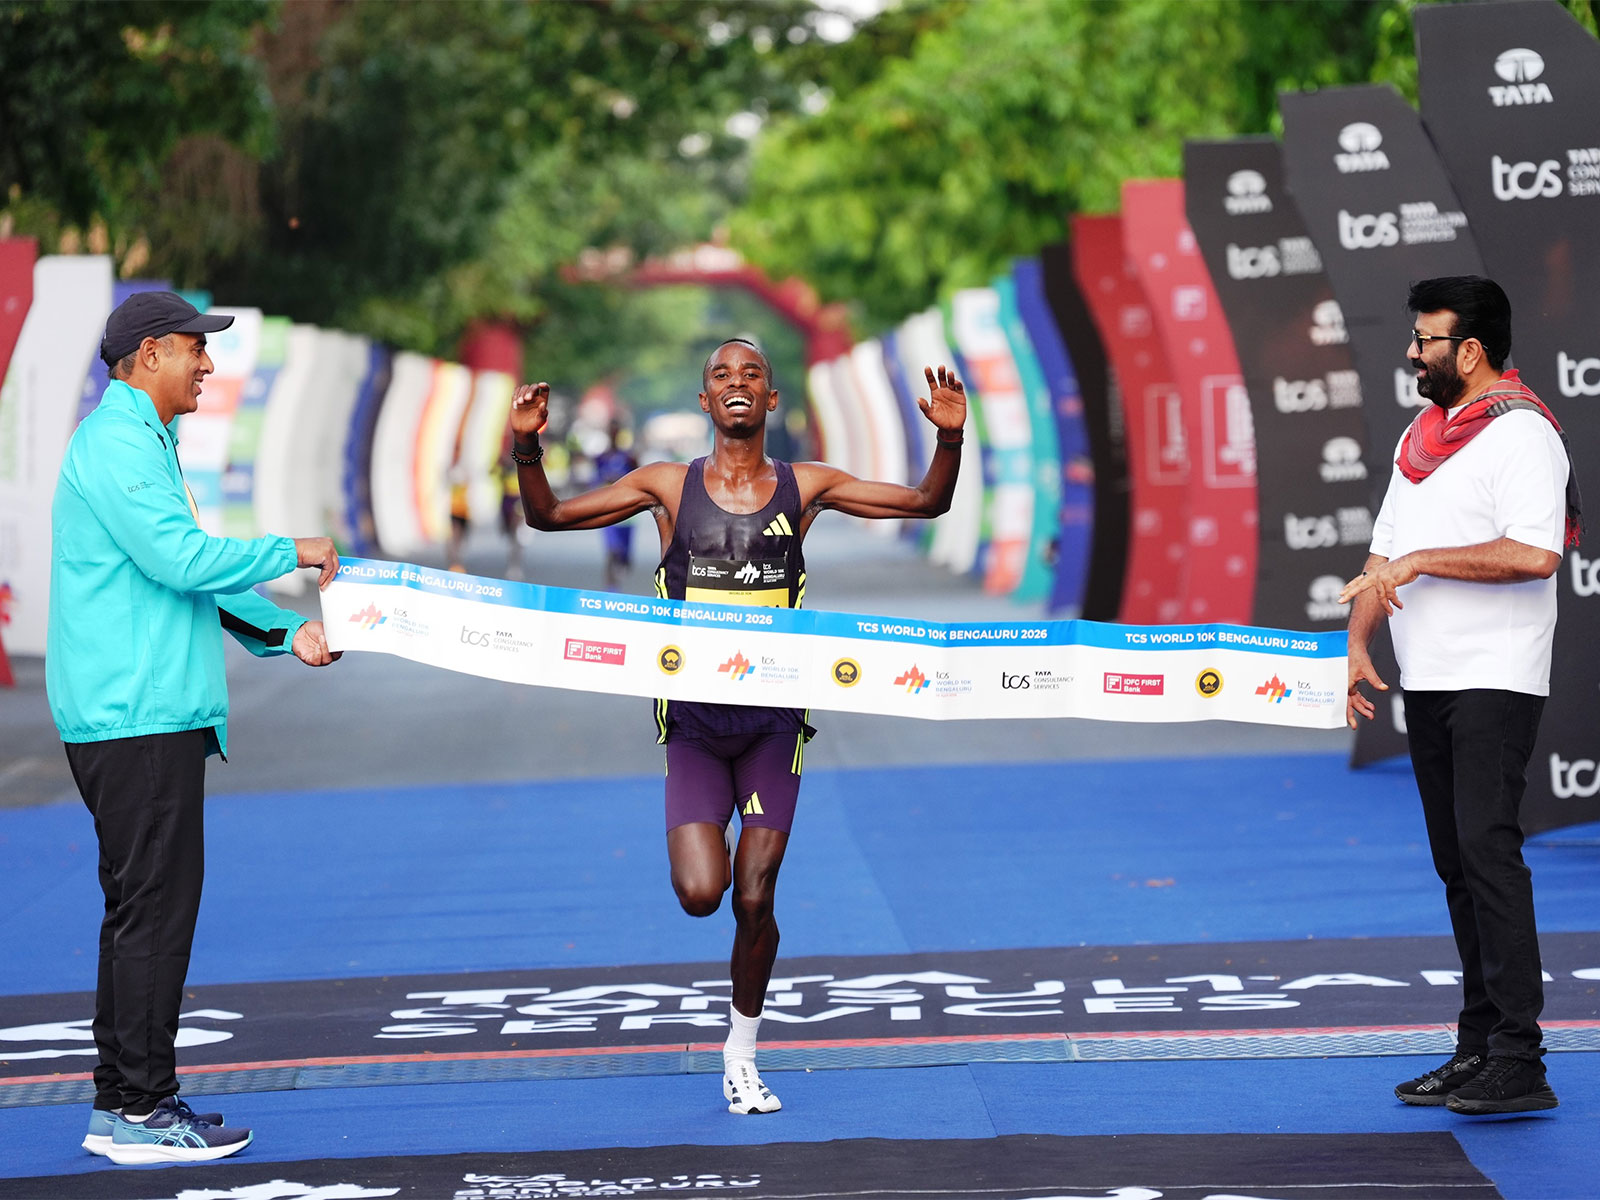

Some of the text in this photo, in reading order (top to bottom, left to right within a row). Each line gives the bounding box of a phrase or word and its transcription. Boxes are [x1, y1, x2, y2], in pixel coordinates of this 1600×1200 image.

[1488, 83, 1554, 106] TATA
[1491, 155, 1564, 200] tcs
[1338, 209, 1400, 249] tcs
[692, 565, 707, 577] tcs
[379, 568, 399, 579] 10K
[401, 570, 474, 593] BENGALURU
[476, 584, 503, 598] 2026
[580, 598, 773, 625] TCS WORLD 10K BENGALURU 2026
[460, 625, 491, 648] tcs
[495, 630, 513, 638] TATA
[857, 622, 1048, 640] TCS WORLD 10K BENGALURU 2026
[493, 637, 534, 648] CONSULTANCY
[1125, 632, 1318, 651] TCS WORLD 10K BENGALURU 2026
[493, 643, 520, 653] SERVICES
[585, 645, 623, 655] IDFC FIRST
[585, 652, 602, 661] Bank
[762, 656, 775, 665] tcs
[761, 665, 786, 673] WORLD
[760, 672, 799, 680] BENGALURU
[936, 671, 950, 680] tcs
[1002, 671, 1030, 690] tcs
[1034, 676, 1074, 684] CONSULTANCY
[1124, 678, 1161, 687] IDFC FIRST
[1298, 680, 1311, 689] tcs
[1550, 752, 1600, 798] tc
[373, 993, 1301, 1039] SERVICES
